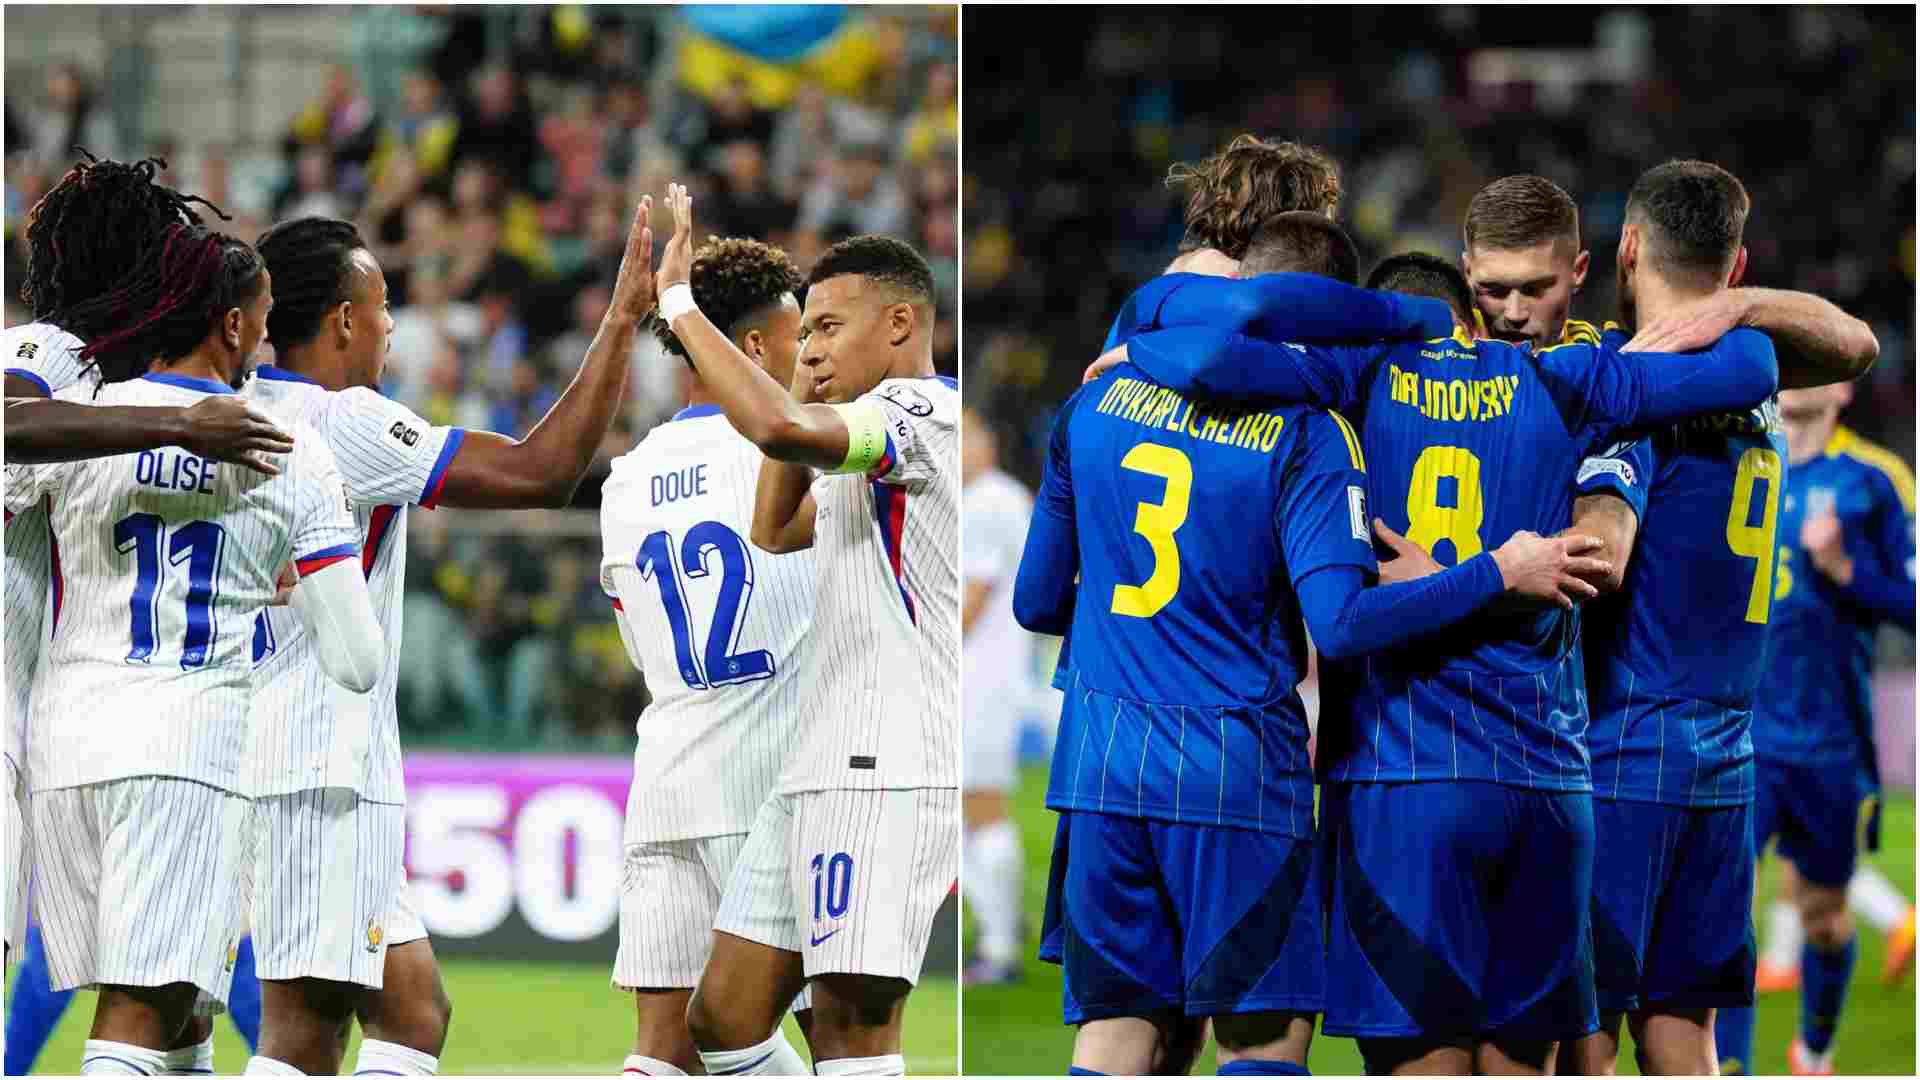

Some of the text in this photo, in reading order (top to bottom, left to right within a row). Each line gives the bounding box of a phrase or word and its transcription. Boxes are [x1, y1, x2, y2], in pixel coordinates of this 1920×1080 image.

[135, 449, 216, 496] OLISE
[651, 463, 708, 508] DOUE
[1111, 443, 1193, 618] 3
[1407, 446, 1485, 567] 8
[1726, 447, 1782, 624] 9
[113, 512, 227, 671] 11
[635, 520, 776, 690] 12
[404, 784, 626, 940] 50
[810, 851, 855, 921] 10
